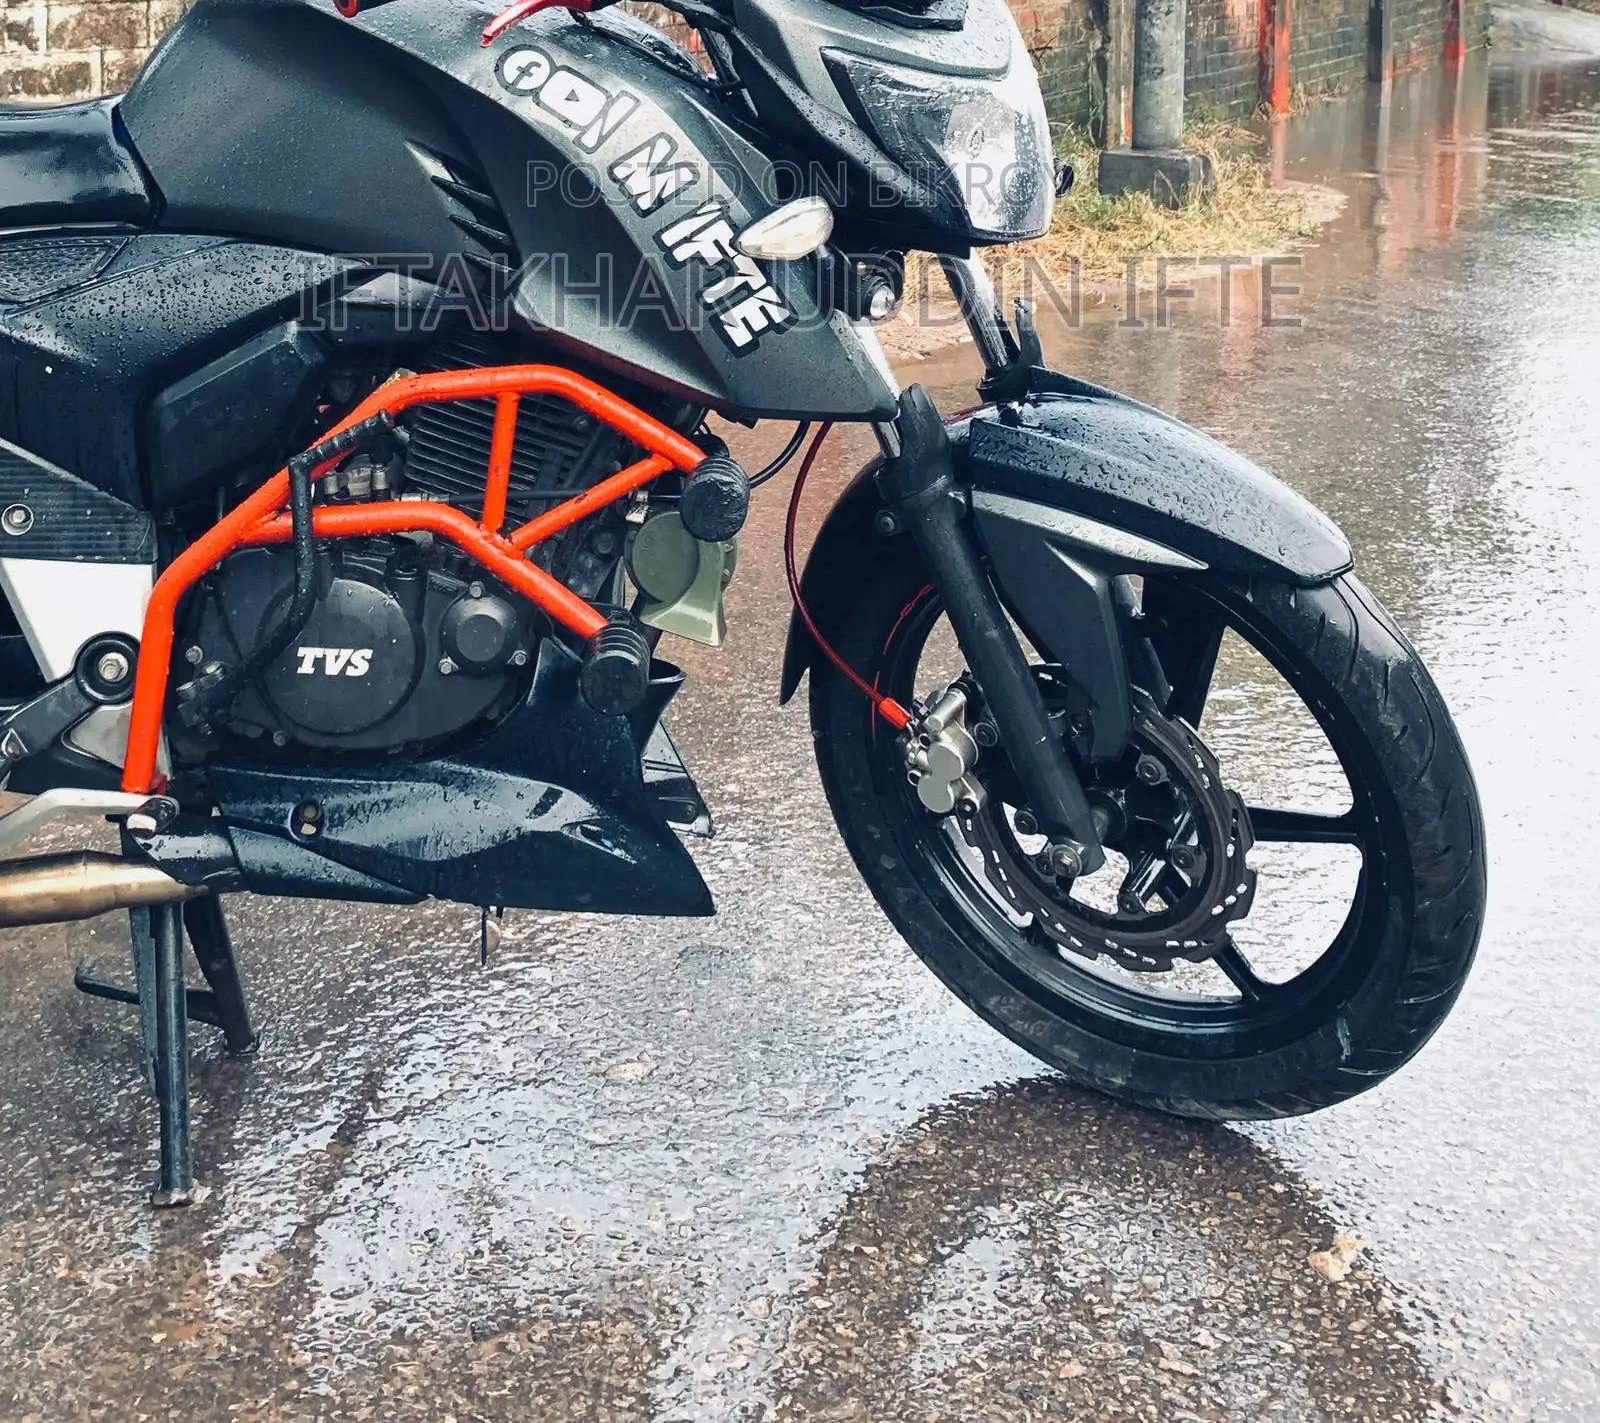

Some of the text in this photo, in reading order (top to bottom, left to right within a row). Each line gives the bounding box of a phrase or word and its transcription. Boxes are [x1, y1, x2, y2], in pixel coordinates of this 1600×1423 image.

[610, 135, 792, 350] M IFTE
[296, 646, 374, 677] TVS
